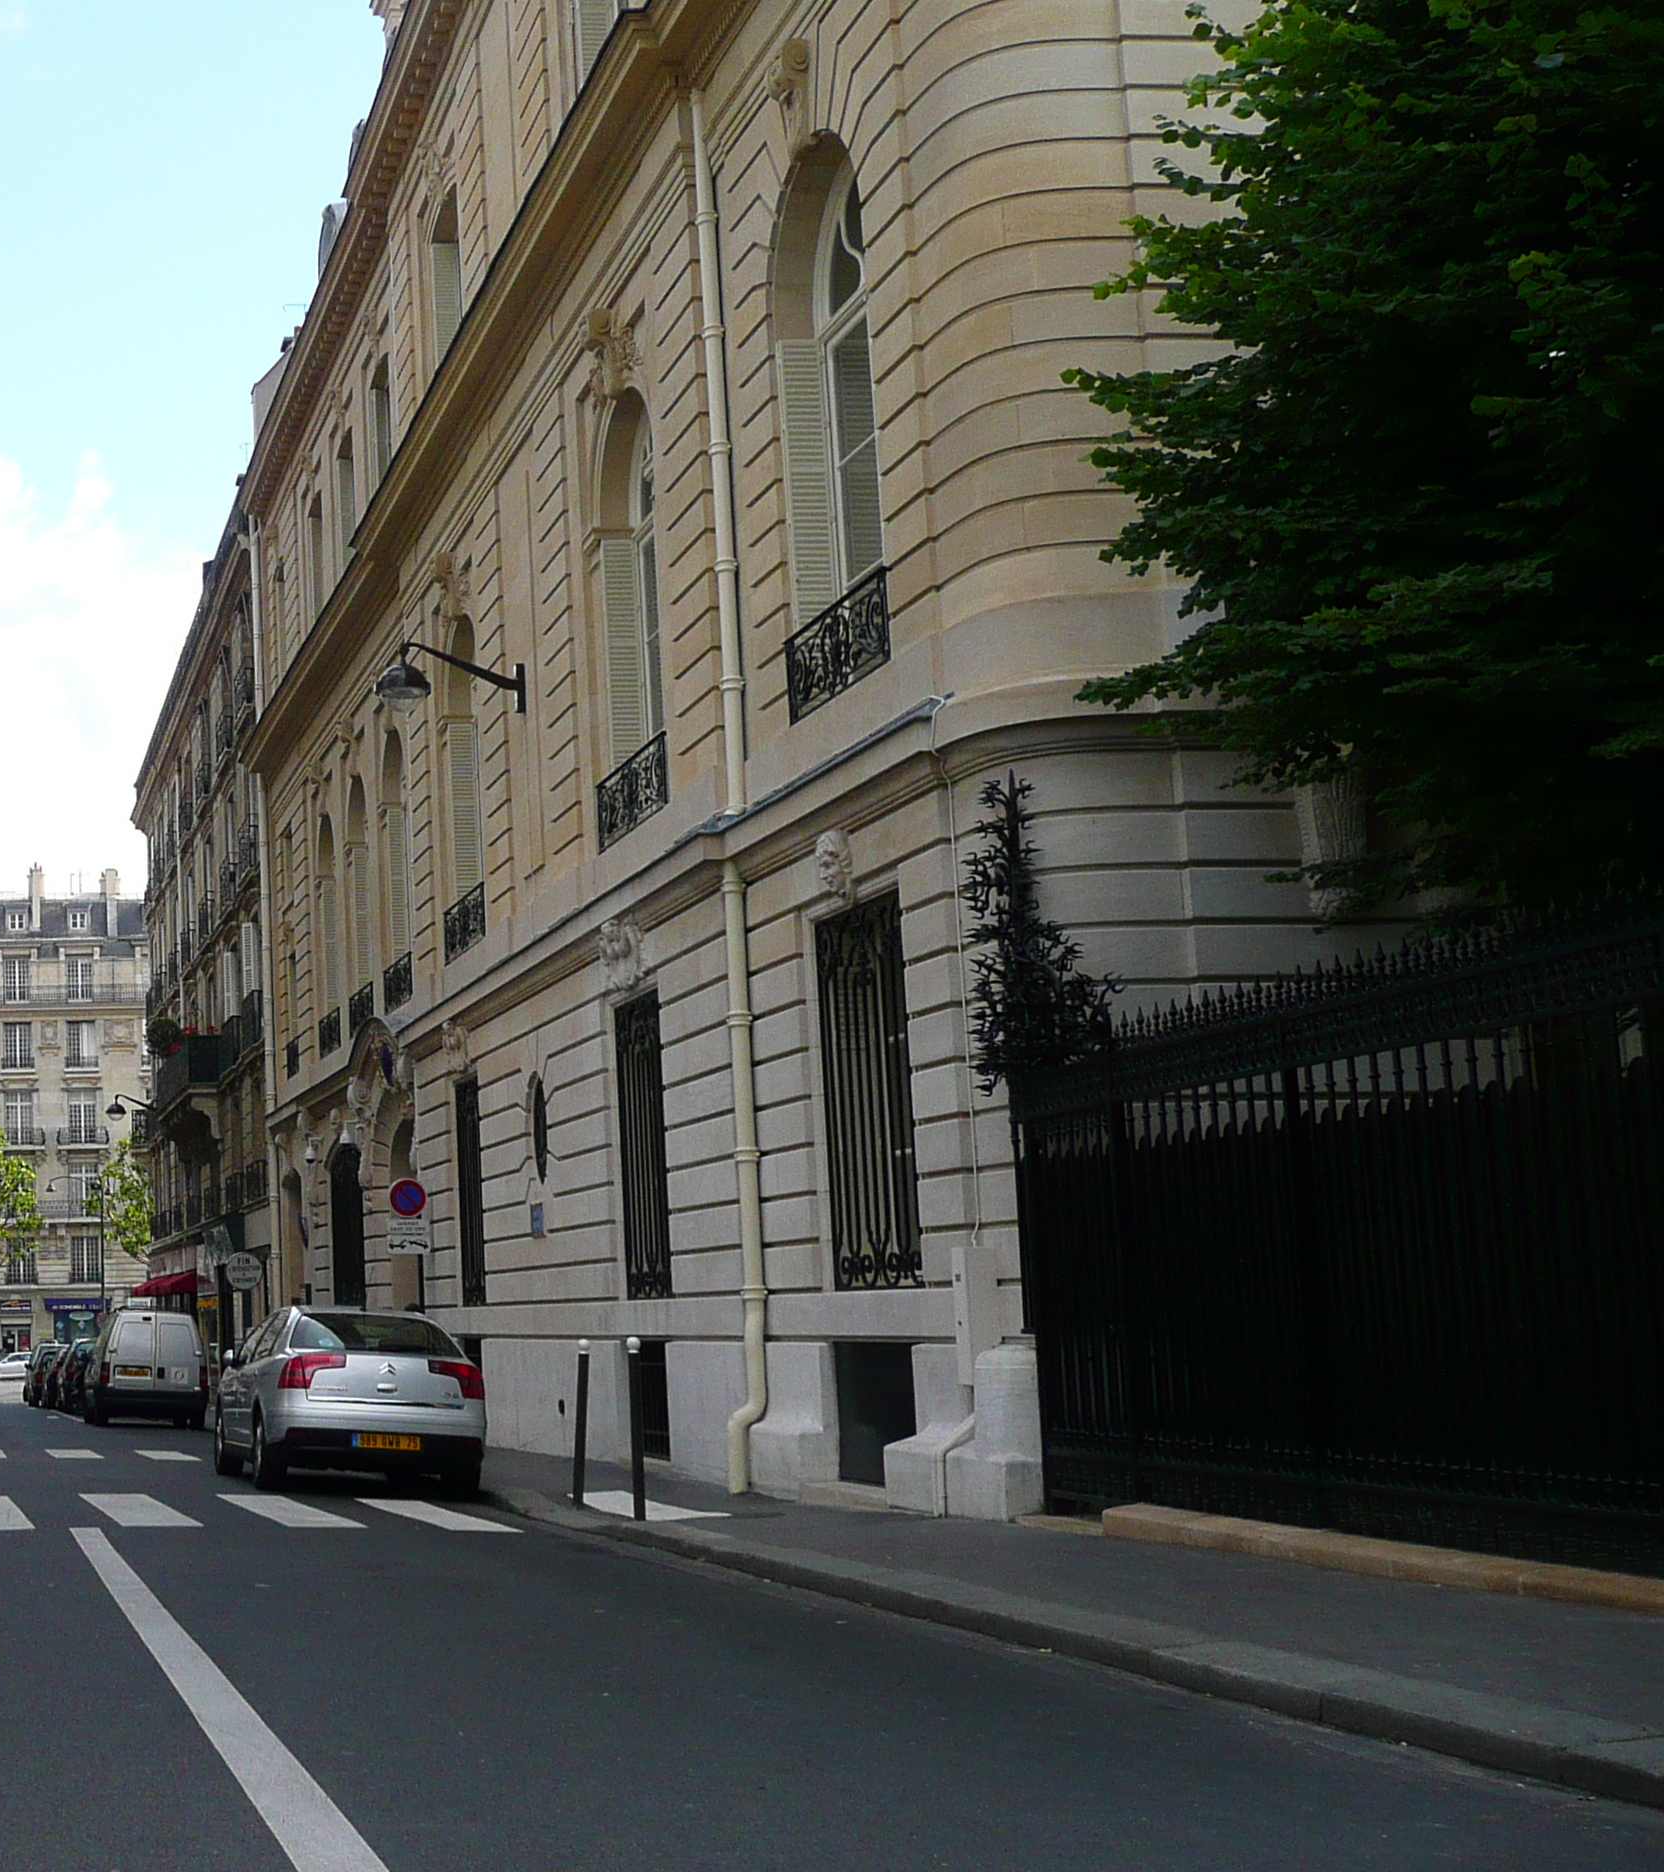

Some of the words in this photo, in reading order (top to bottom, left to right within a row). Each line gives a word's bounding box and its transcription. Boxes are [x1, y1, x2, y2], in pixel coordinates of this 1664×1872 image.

[237, 1256, 251, 1265] FIN
[359, 1433, 378, 1447] 989
[406, 1435, 419, 1449] 75
